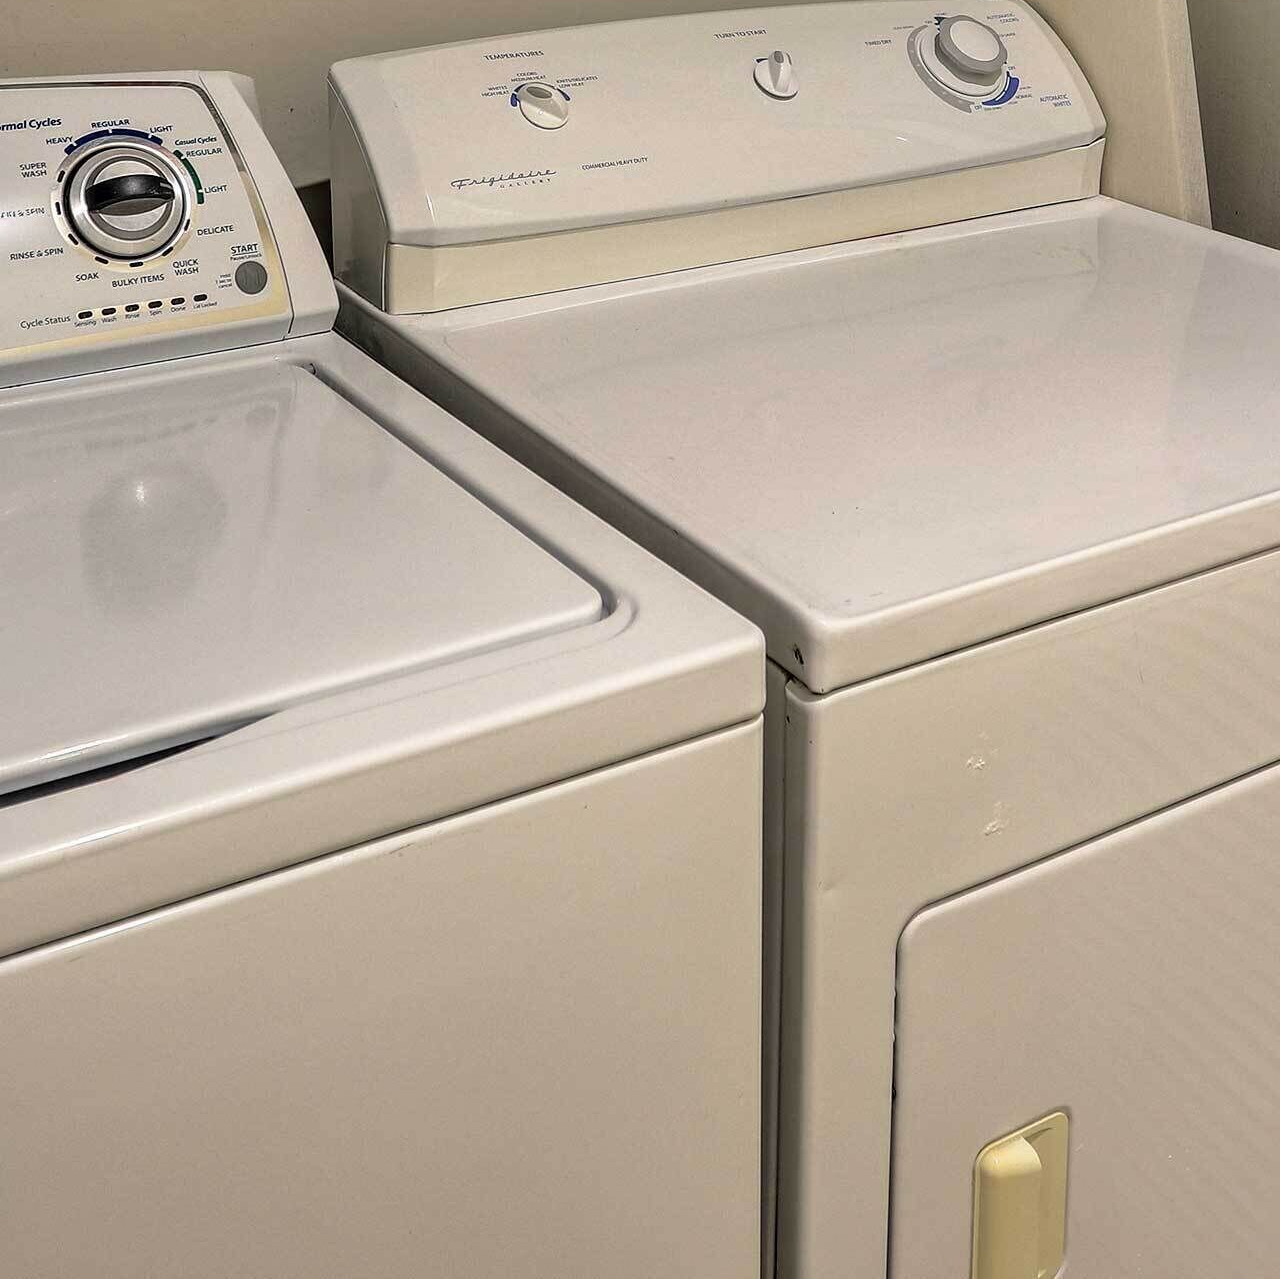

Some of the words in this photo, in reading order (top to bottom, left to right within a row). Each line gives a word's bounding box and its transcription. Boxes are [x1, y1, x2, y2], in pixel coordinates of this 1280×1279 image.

[484, 50, 544, 61] TEMPERATURES
[1040, 94, 1069, 102] AUTOMATIC
[29, 118, 62, 130] Cycles
[91, 119, 130, 129] REGULAR
[150, 125, 174, 134] LIGHT
[46, 136, 73, 145] HEAVY
[174, 138, 197, 146] Casual
[198, 136, 217, 144] Cycles
[186, 148, 223, 158] REGULAR
[20, 162, 47, 171] SUPER
[582, 162, 616, 171] COMMERCIAL
[616, 160, 633, 168] HEAVY
[634, 157, 649, 165] DUTY
[21, 170, 48, 178] WASH
[451, 169, 557, 190] Frigidaire
[500, 178, 552, 189] GALLERY
[204, 184, 228, 194] LIGHT
[25, 208, 45, 216] SPIN
[197, 224, 235, 236] DELICATE
[231, 243, 259, 254] START
[10, 250, 35, 261] RINSE
[36, 250, 43, 258] &
[44, 248, 64, 257] SPIN
[172, 258, 199, 269] QUICK
[174, 266, 200, 276] WASH
[76, 272, 100, 282] SOAK
[112, 278, 139, 288] BULKY
[140, 274, 165, 284] ITEMS
[20, 319, 43, 330] Cycle
[44, 316, 71, 326] Status
[74, 319, 97, 328] Sensing
[100, 316, 118, 324] Wash
[125, 312, 140, 320] Rinse
[150, 309, 163, 317] Spin
